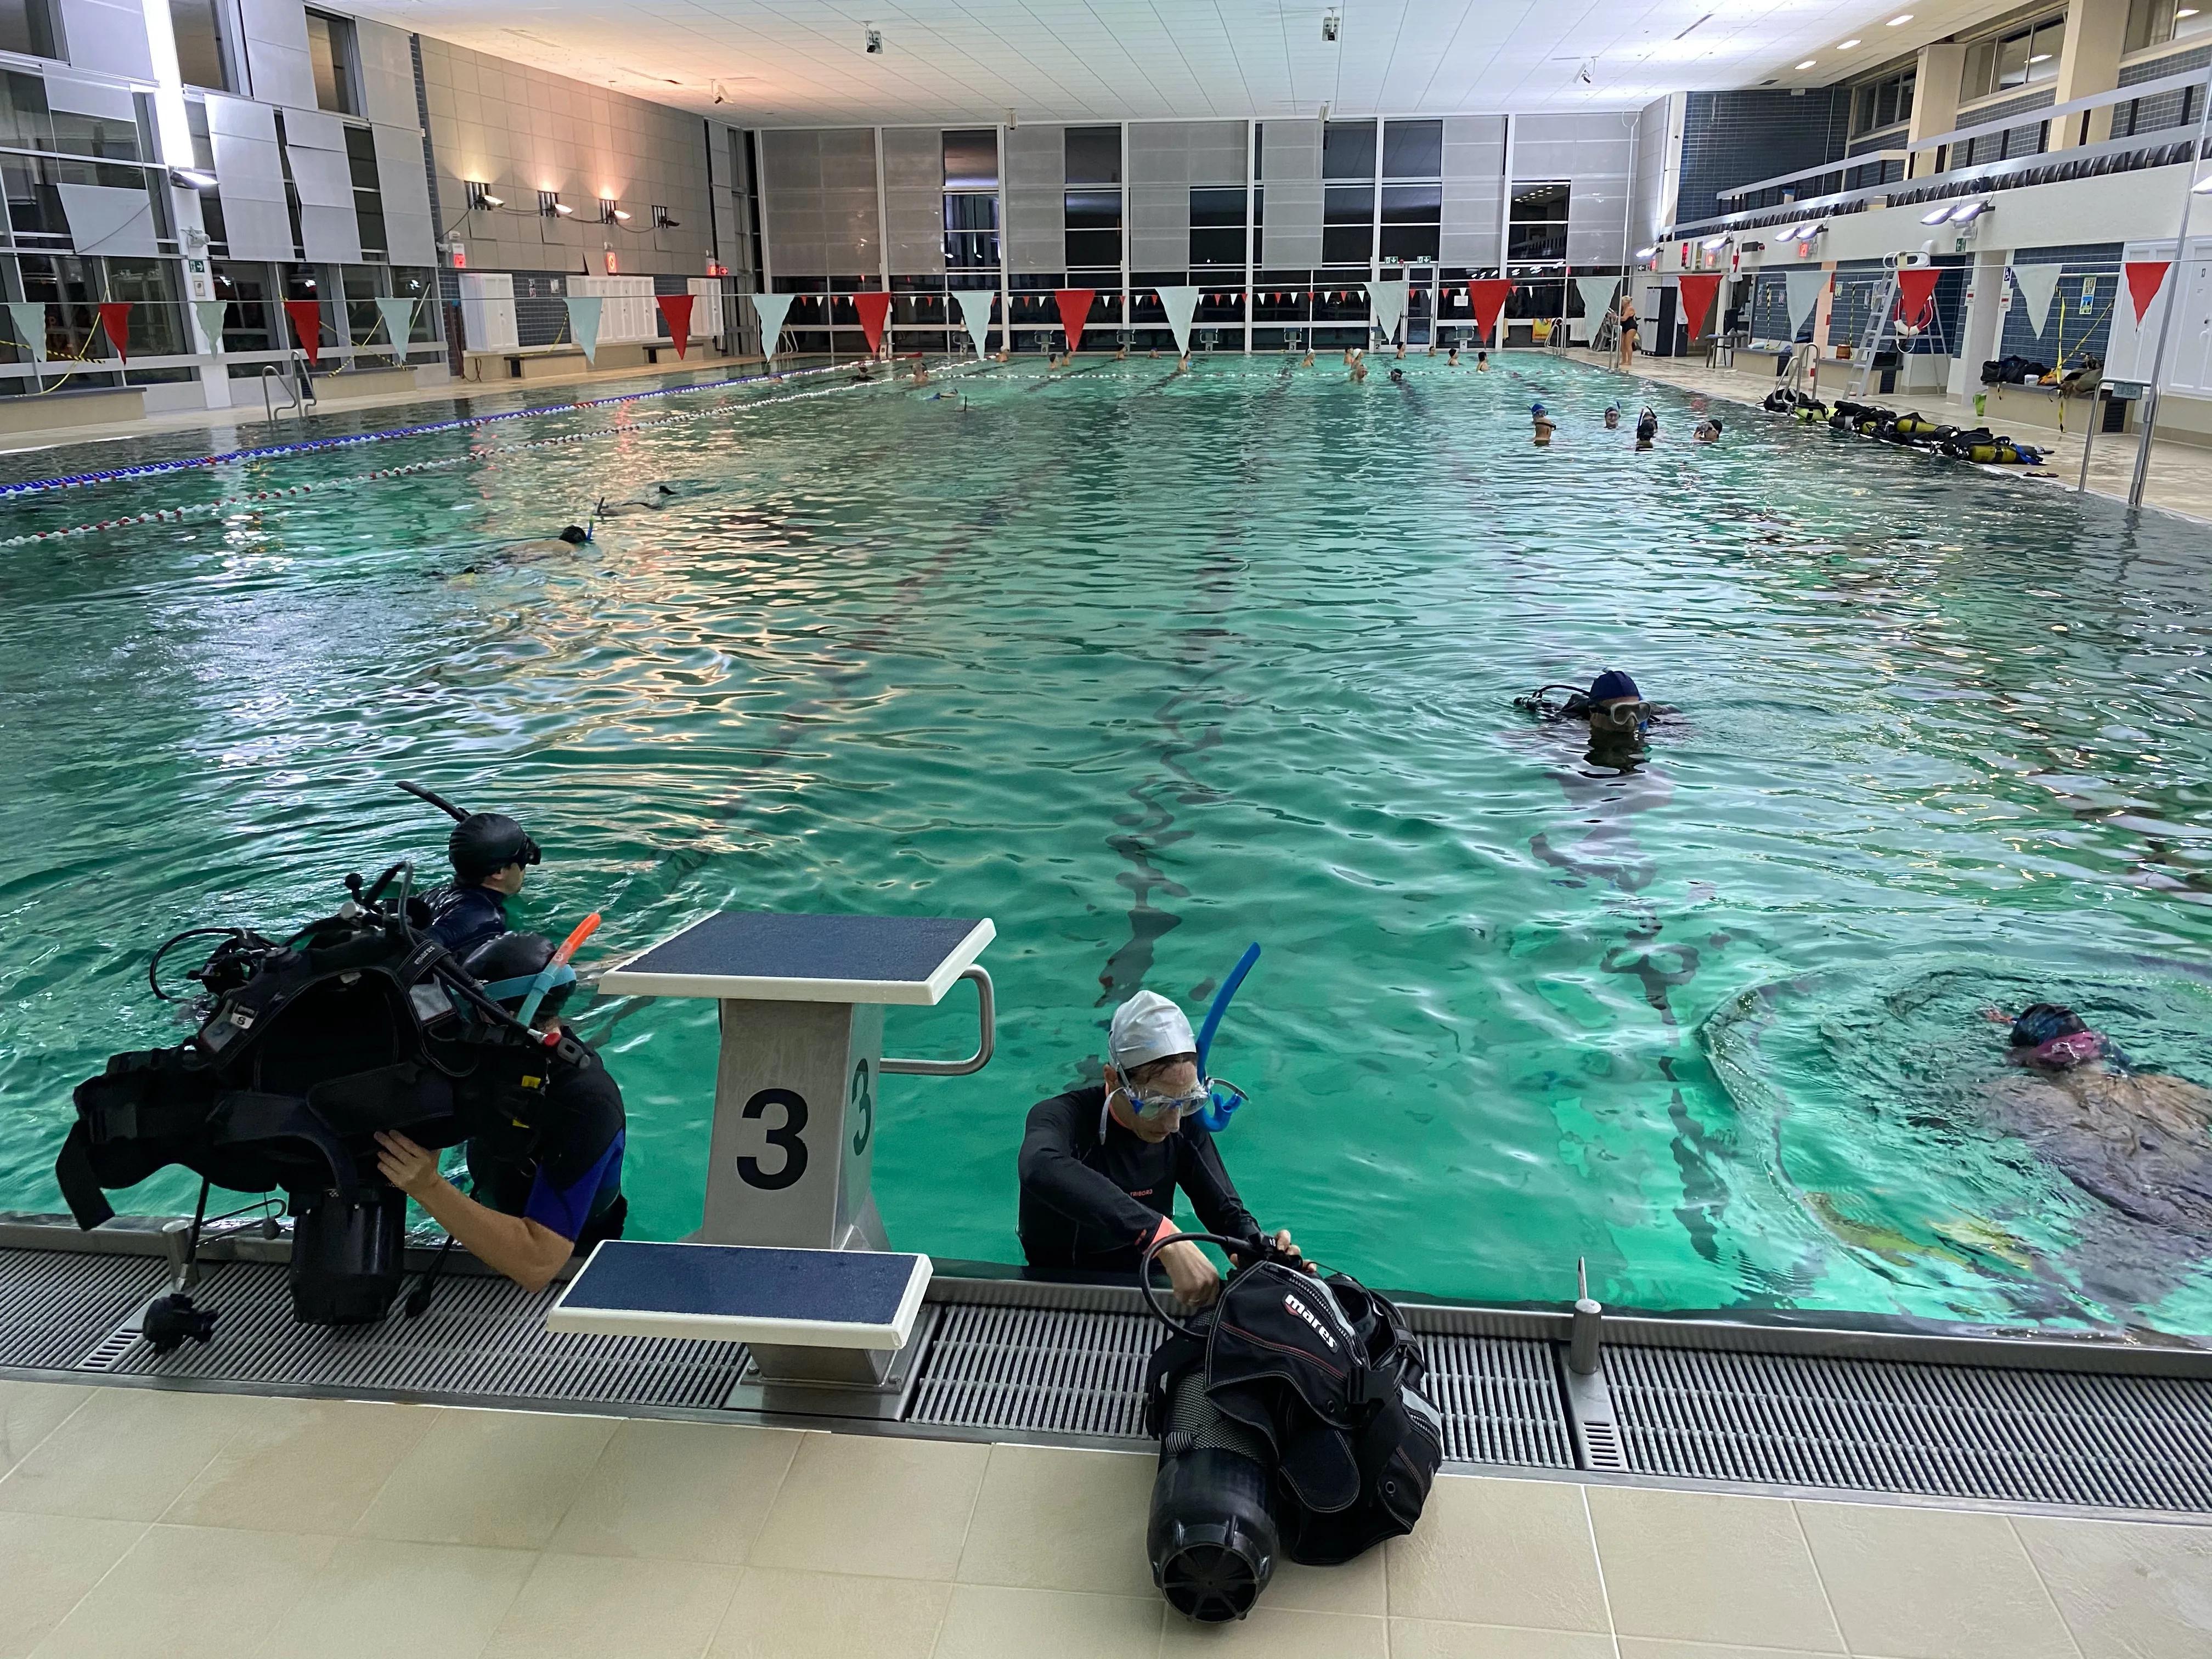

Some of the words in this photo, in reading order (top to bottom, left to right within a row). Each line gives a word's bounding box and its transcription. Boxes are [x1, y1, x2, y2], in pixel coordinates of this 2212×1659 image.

[737, 1088, 808, 1190] 3
[851, 1058, 871, 1156] 3
[1285, 1294, 1338, 1347] mares
